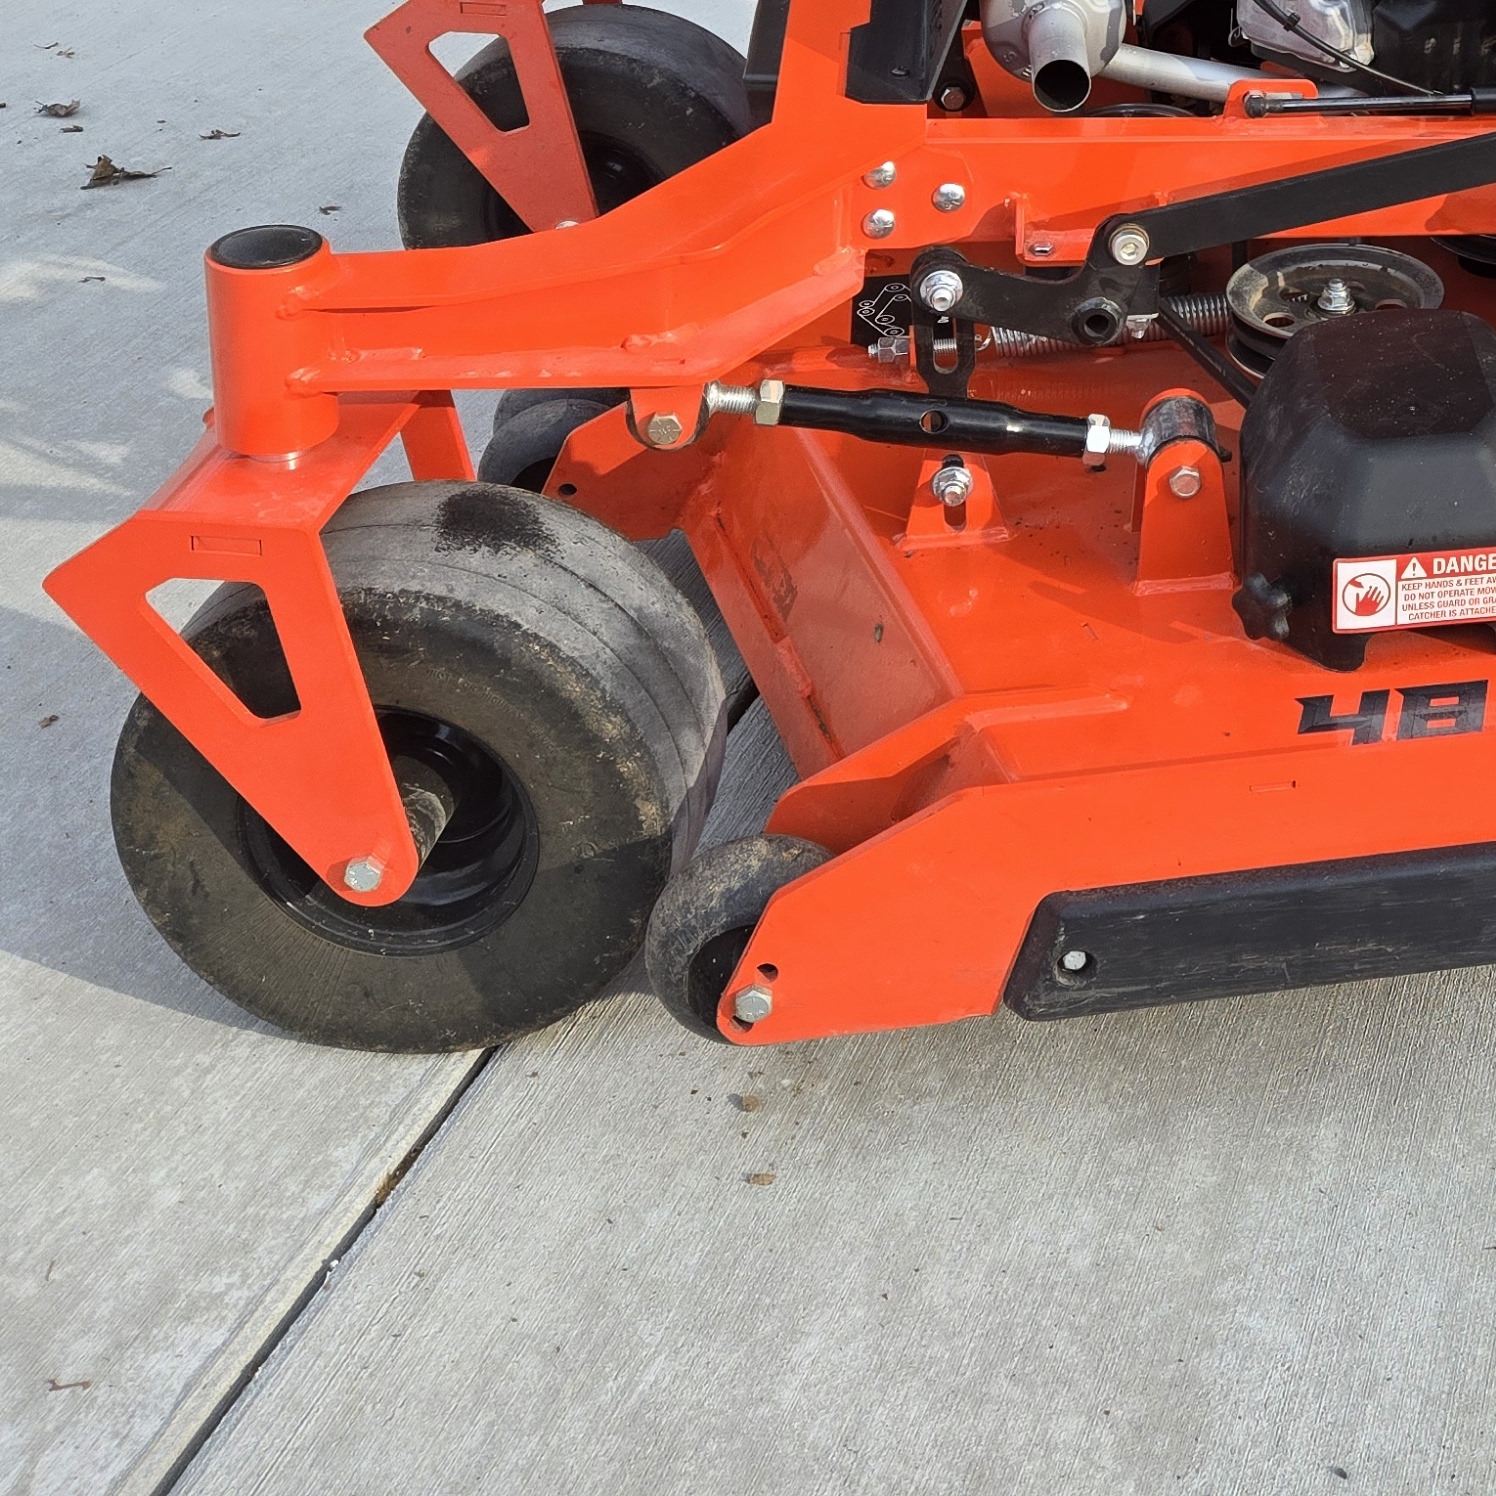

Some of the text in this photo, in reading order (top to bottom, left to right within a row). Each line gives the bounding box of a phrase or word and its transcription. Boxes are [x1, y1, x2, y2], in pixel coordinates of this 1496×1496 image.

[1401, 582, 1423, 591] KEEP
[1425, 579, 1454, 589] HANDS
[1456, 578, 1463, 587] &
[1464, 577, 1484, 587] FEET
[1404, 593, 1416, 601] DO
[1418, 591, 1435, 600] NOT
[1437, 588, 1475, 599] OPERATE
[1402, 602, 1435, 612] UNLESS
[1437, 599, 1467, 609] GUARD
[1469, 597, 1480, 606] OR
[1408, 610, 1447, 621] CATCHER
[1449, 609, 1457, 617] IS
[1294, 679, 1489, 746] 48
